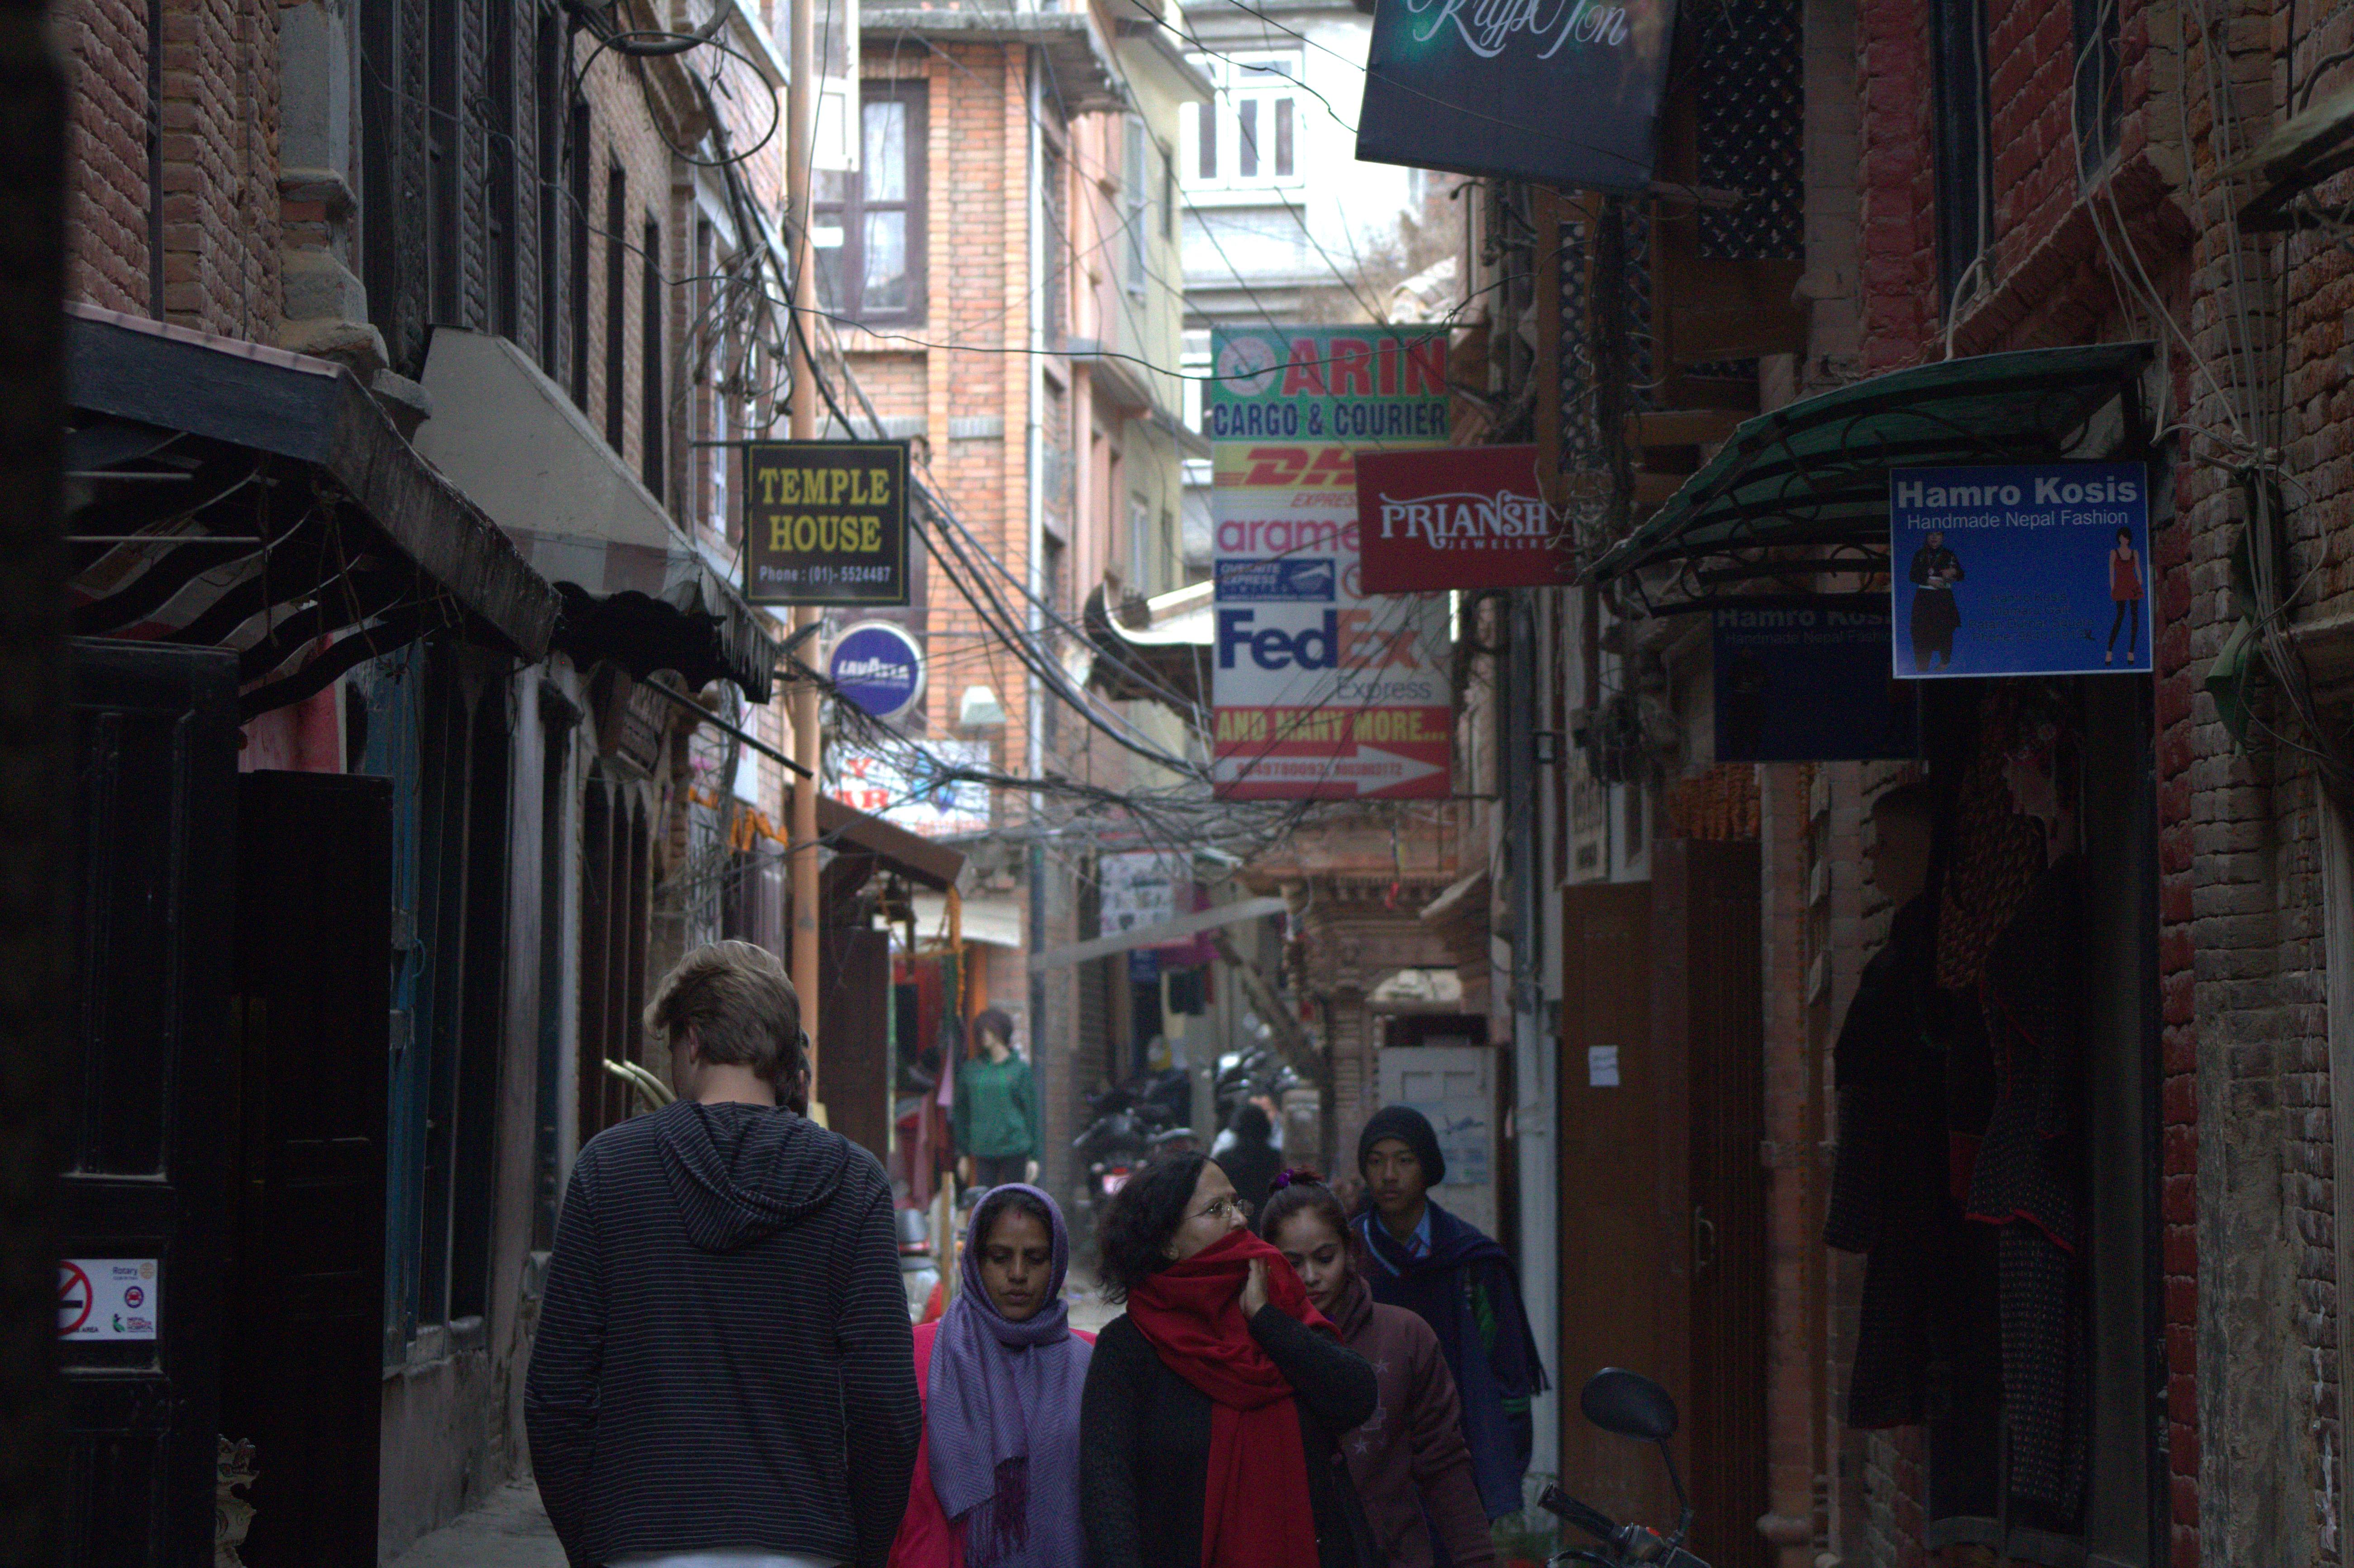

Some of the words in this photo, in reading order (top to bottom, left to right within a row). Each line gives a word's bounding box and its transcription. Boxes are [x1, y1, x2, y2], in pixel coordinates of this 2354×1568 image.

[1280, 337, 1448, 397] ARIN
[1213, 402, 1299, 437] CARGO
[1308, 404, 1324, 436] &
[1334, 402, 1446, 438] COURIER
[1245, 447, 1356, 486] DH
[758, 467, 891, 506] TEMPLE
[1897, 479, 2021, 508] Hamro
[2035, 475, 2138, 505] Kosis
[768, 515, 882, 553] HOUSE
[1217, 519, 1359, 553] arame
[1379, 489, 1549, 549] PRIANSH
[1907, 512, 2001, 530] Handmade
[2005, 510, 2056, 531] Nepal
[2061, 509, 2128, 527] Fashion
[1718, 609, 1816, 627] Hamro
[1968, 619, 2003, 629] Patan
[2007, 618, 2047, 629] Durbar
[2052, 616, 2094, 629] Square
[1219, 609, 1422, 670] FedEx
[1725, 632, 1800, 646] Handmade
[1804, 631, 1843, 645] Nepal
[838, 658, 909, 679] LAVAZZA
[1337, 676, 1433, 699] Express
[1217, 710, 1266, 742] AND
[1275, 710, 1344, 742] MANY
[1352, 709, 1448, 743] MORE...
[113, 1267, 137, 1276] Rotary
